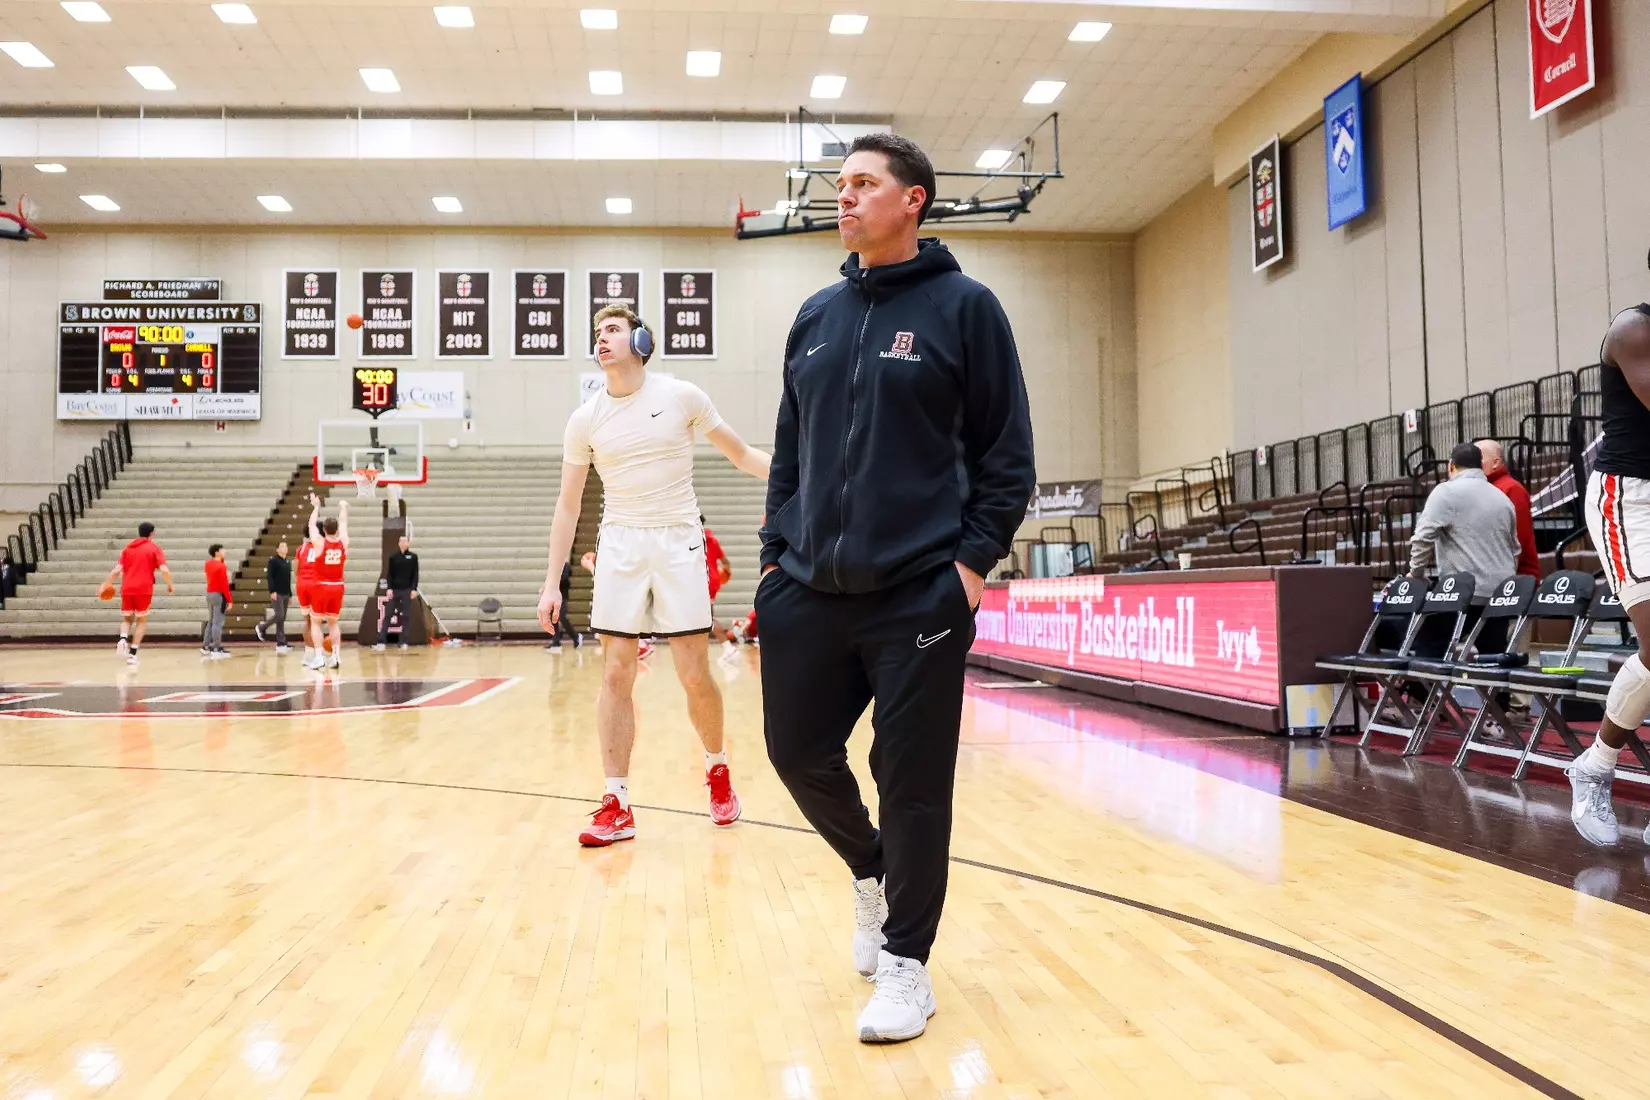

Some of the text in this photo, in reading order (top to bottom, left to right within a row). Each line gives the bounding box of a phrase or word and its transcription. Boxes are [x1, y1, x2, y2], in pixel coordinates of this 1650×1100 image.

[104, 281, 143, 290] RICHARD
[145, 281, 155, 290] A.
[158, 281, 201, 290] FRIEDMAN
[130, 290, 189, 298] SCOREBOARD
[81, 306, 239, 319] BROWN UNIVERSITY
[295, 308, 326, 320] NCAA
[372, 308, 403, 320] NCAA
[452, 311, 476, 326] NIT
[528, 311, 552, 326] CBI
[676, 311, 700, 326] CBI
[138, 325, 184, 342] 90:00
[294, 333, 328, 348] 1939
[446, 333, 482, 349] 2003
[522, 333, 558, 349] 2008
[671, 333, 706, 349] 2019
[122, 353, 134, 368] 0
[160, 354, 166, 367] 1
[201, 353, 213, 368] 0
[879, 350, 922, 362] BASKETBALL
[111, 374, 121, 387] 0
[202, 374, 213, 387] 0
[356, 369, 394, 384] 90:00
[362, 383, 389, 405] 30
[325, 549, 342, 565] 22
[1386, 594, 1413, 604] LEXUS
[1429, 592, 1460, 602] LEXUS
[1490, 595, 1520, 606] LEXUS
[1538, 593, 1576, 604] LEXUS
[1007, 599, 1078, 665] University
[1080, 596, 1195, 668] Basketball
[1216, 620, 1246, 672] Ivy
